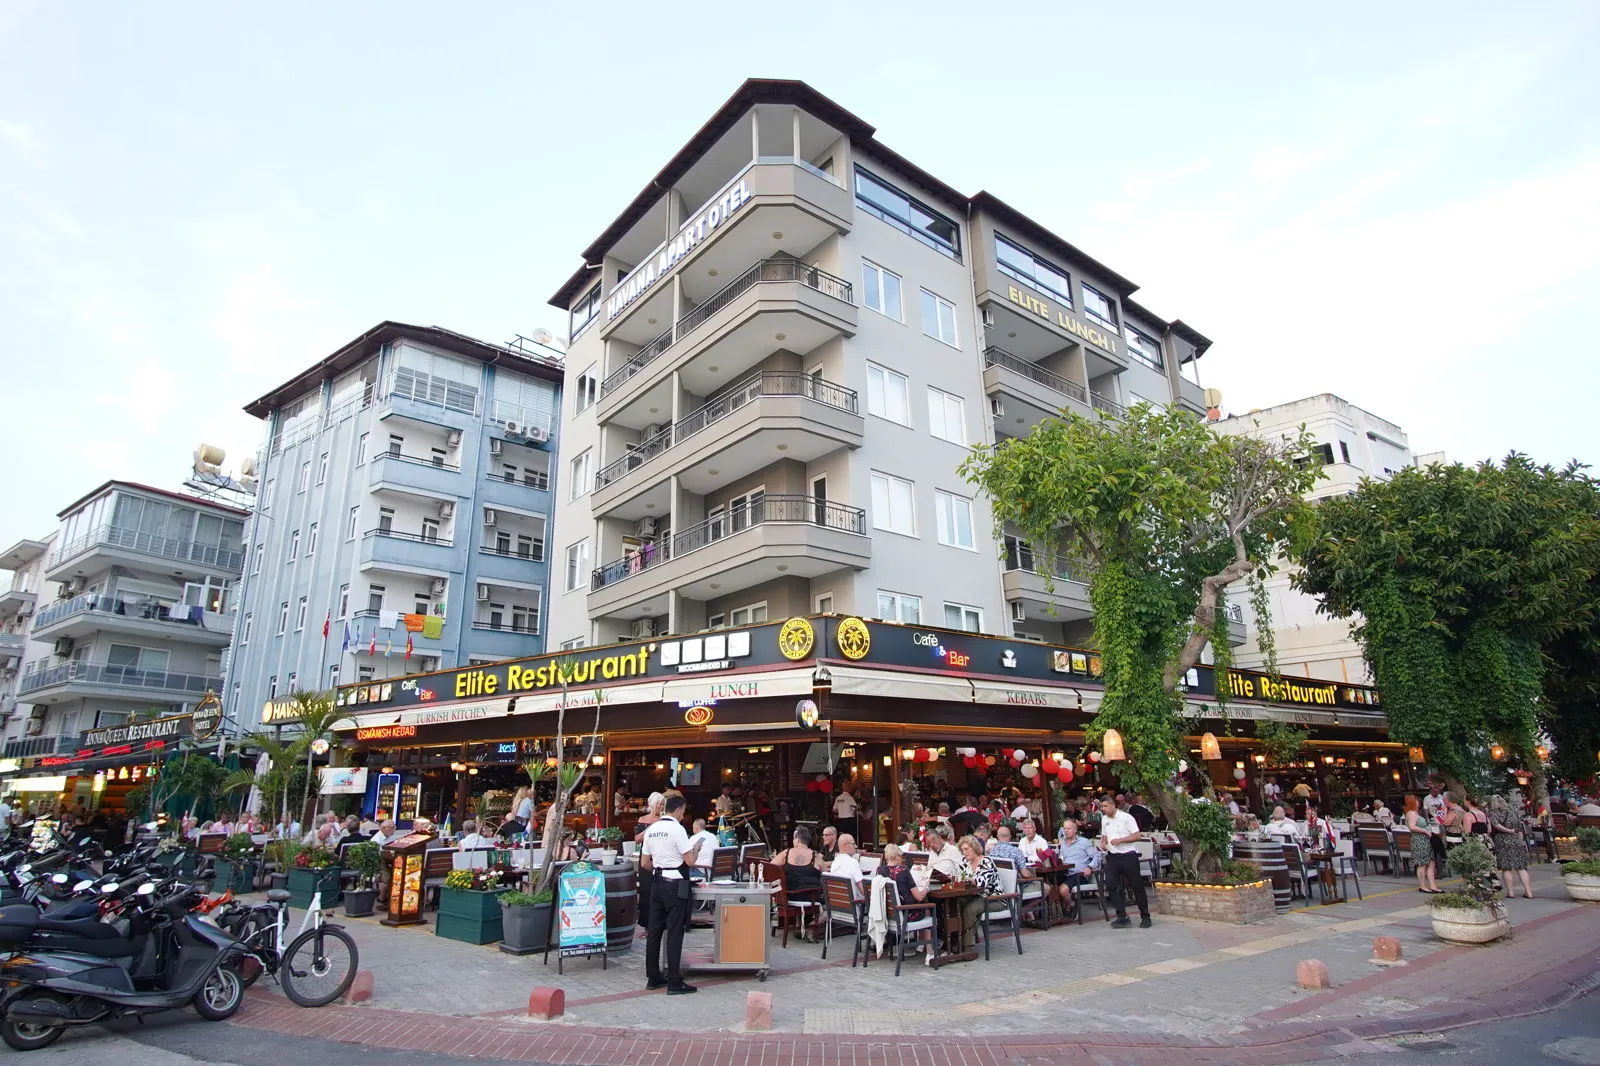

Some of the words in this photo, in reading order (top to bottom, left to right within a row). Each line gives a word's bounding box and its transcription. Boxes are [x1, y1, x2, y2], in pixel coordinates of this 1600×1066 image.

[607, 263, 656, 320] HAVANA
[658, 215, 707, 276] APART
[708, 178, 752, 229] OTEL
[1008, 284, 1049, 319] ELITE
[1058, 311, 1109, 351] LUNCH
[949, 651, 970, 667] Bar
[455, 671, 498, 698] Elite
[508, 646, 650, 691] Restaurant
[420, 690, 433, 701] Bar
[710, 682, 759, 699] LUNCH
[1006, 690, 1047, 706] KEBABS
[416, 711, 449, 725] TURKISH
[452, 706, 488, 722] KITCHEN
[103, 727, 128, 745] QUEEN
[128, 719, 180, 743] RESTAURANT
